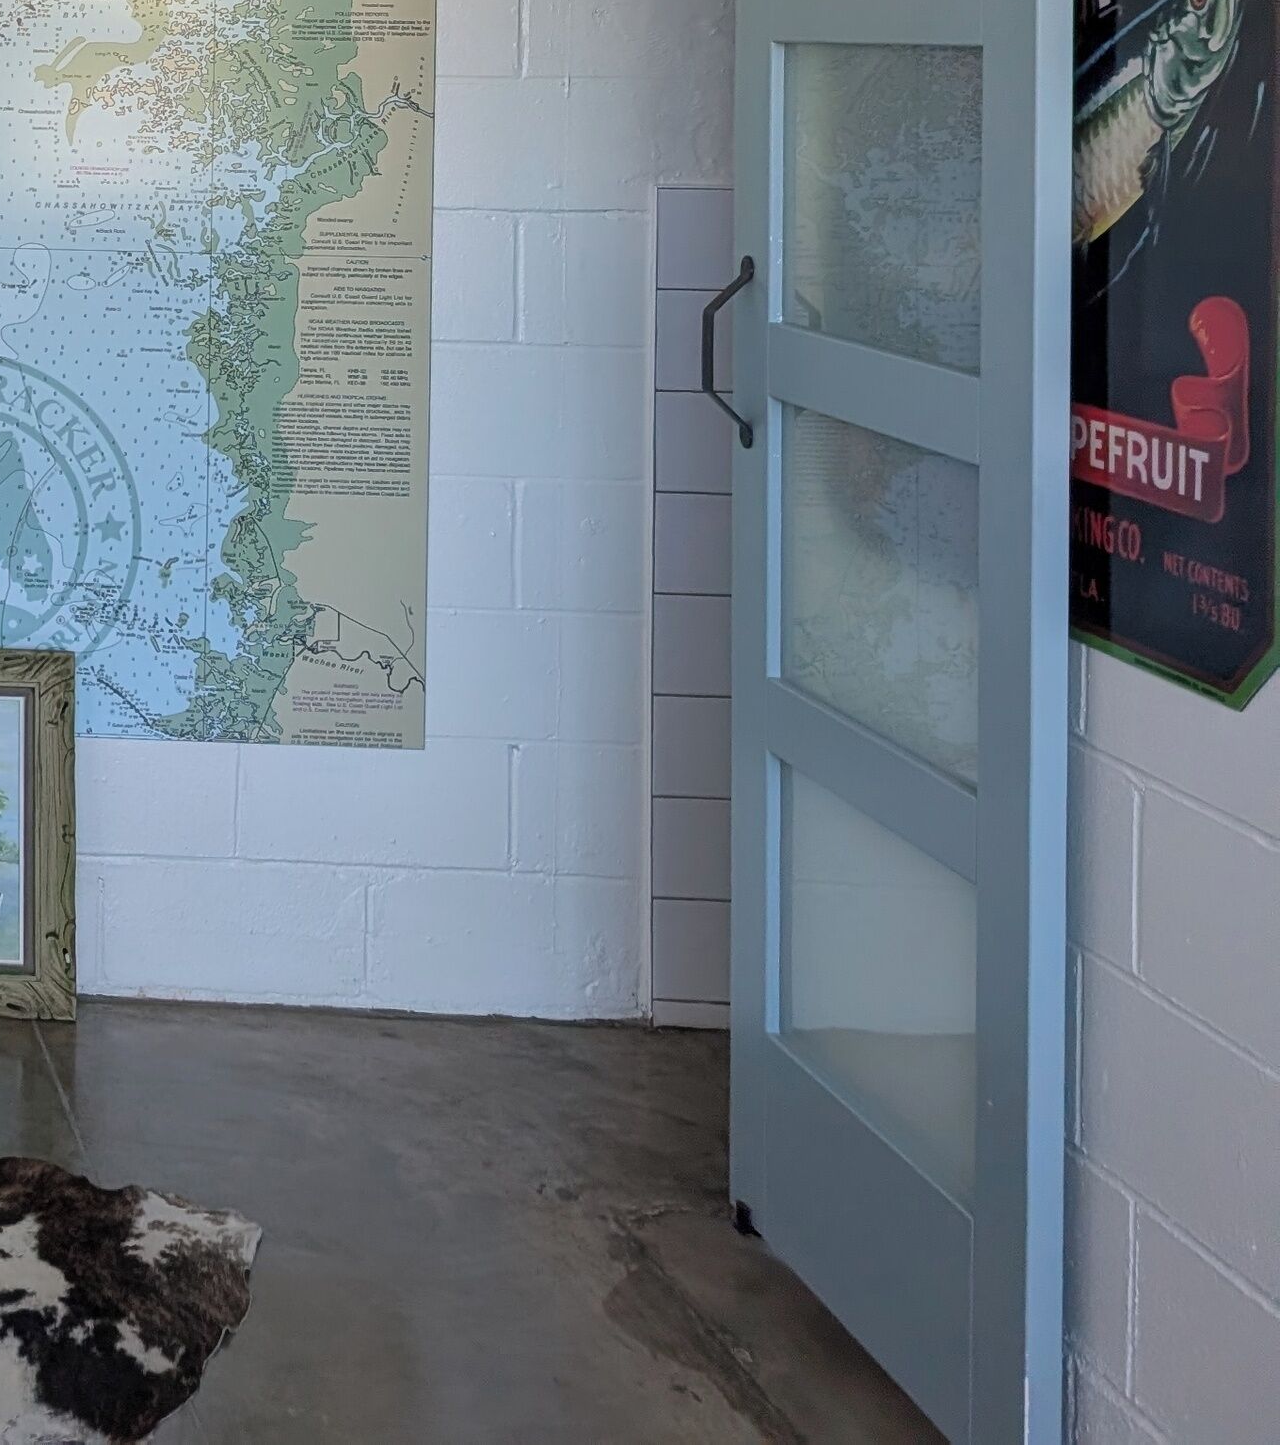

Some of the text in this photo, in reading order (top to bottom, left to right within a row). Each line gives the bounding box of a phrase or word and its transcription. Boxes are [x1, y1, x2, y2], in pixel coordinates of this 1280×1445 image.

[62, 11, 88, 19] BAY
[35, 201, 193, 212] CHASSAHOWITZKA BAY
[1071, 415, 1209, 502] PEFRUIT
[1118, 519, 1145, 564] CO.
[1164, 551, 1249, 602] NET CONTENTS
